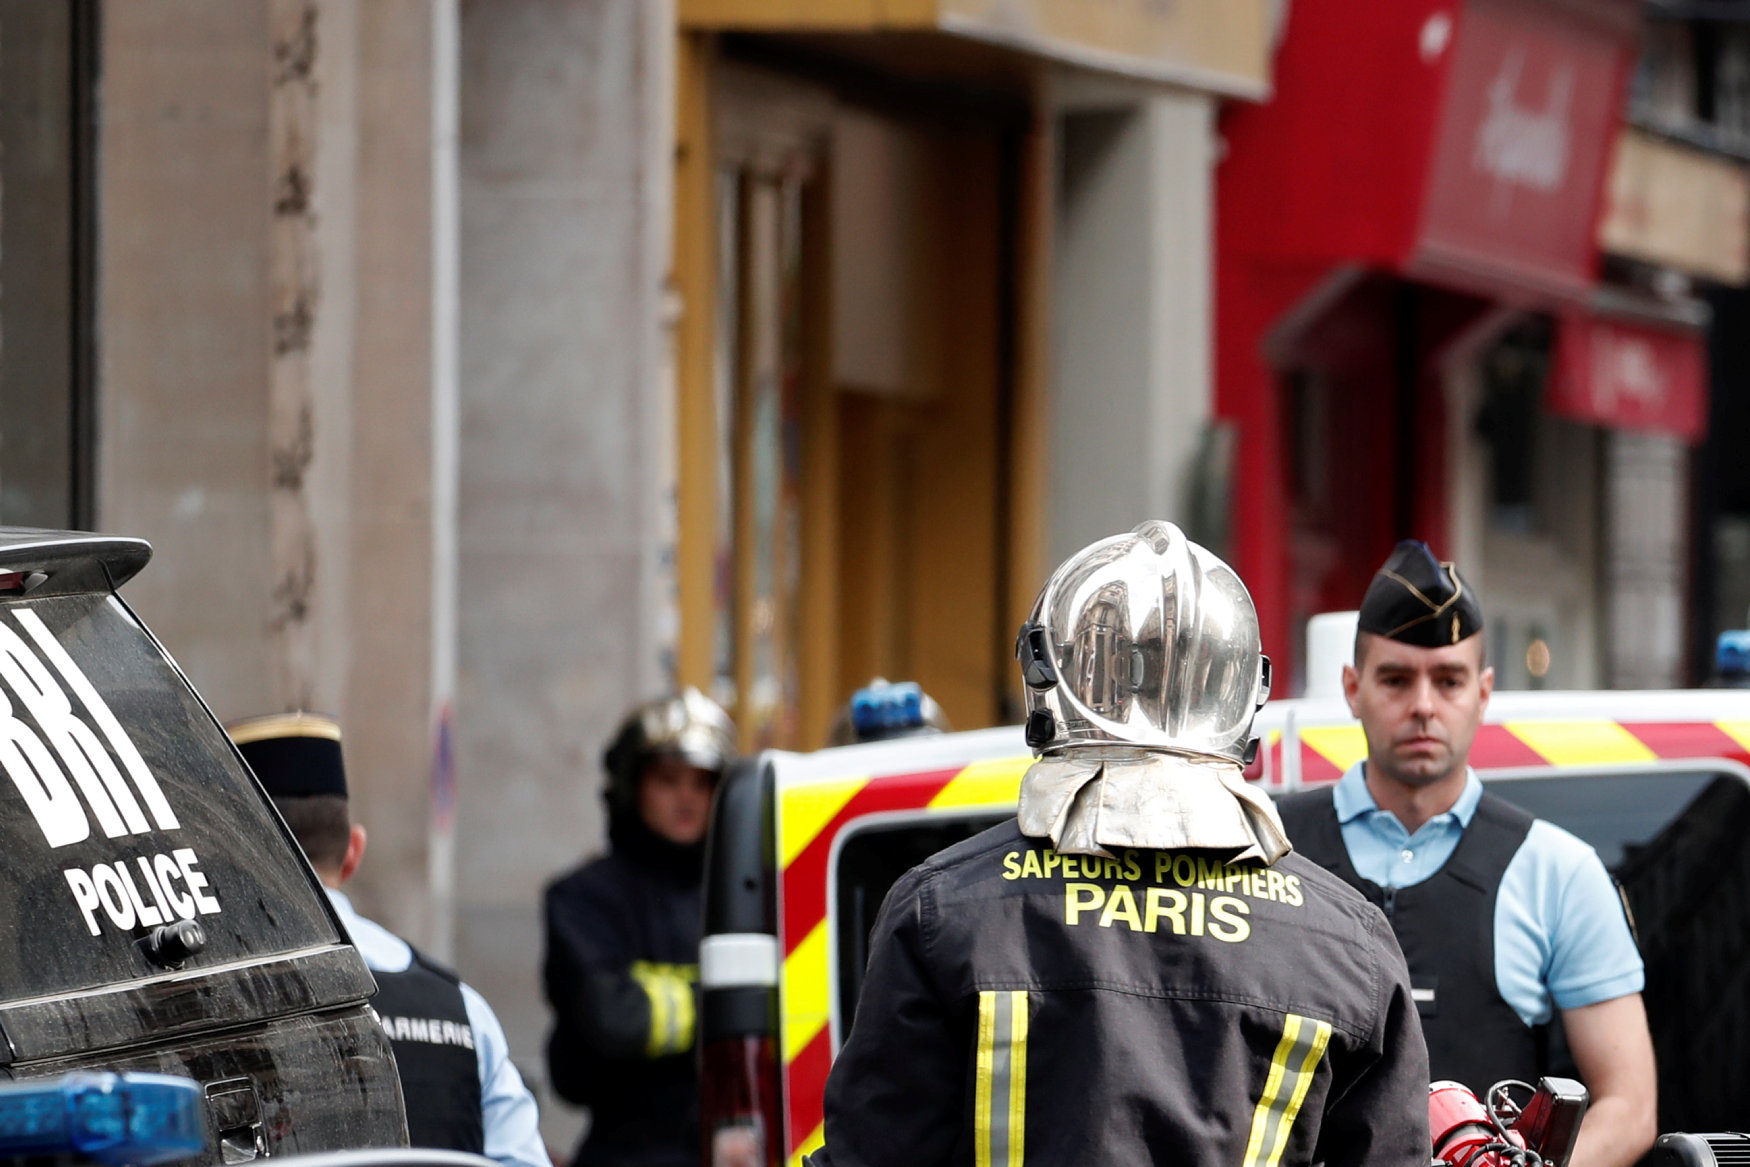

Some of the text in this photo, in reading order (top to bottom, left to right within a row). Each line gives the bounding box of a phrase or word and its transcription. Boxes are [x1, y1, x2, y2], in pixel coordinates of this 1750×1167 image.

[64, 848, 221, 937] POLICE
[1002, 850, 1304, 907] SAPEURS POMPIERS
[1065, 882, 1251, 943] PARIS
[382, 1016, 474, 1050] ARMERIE
